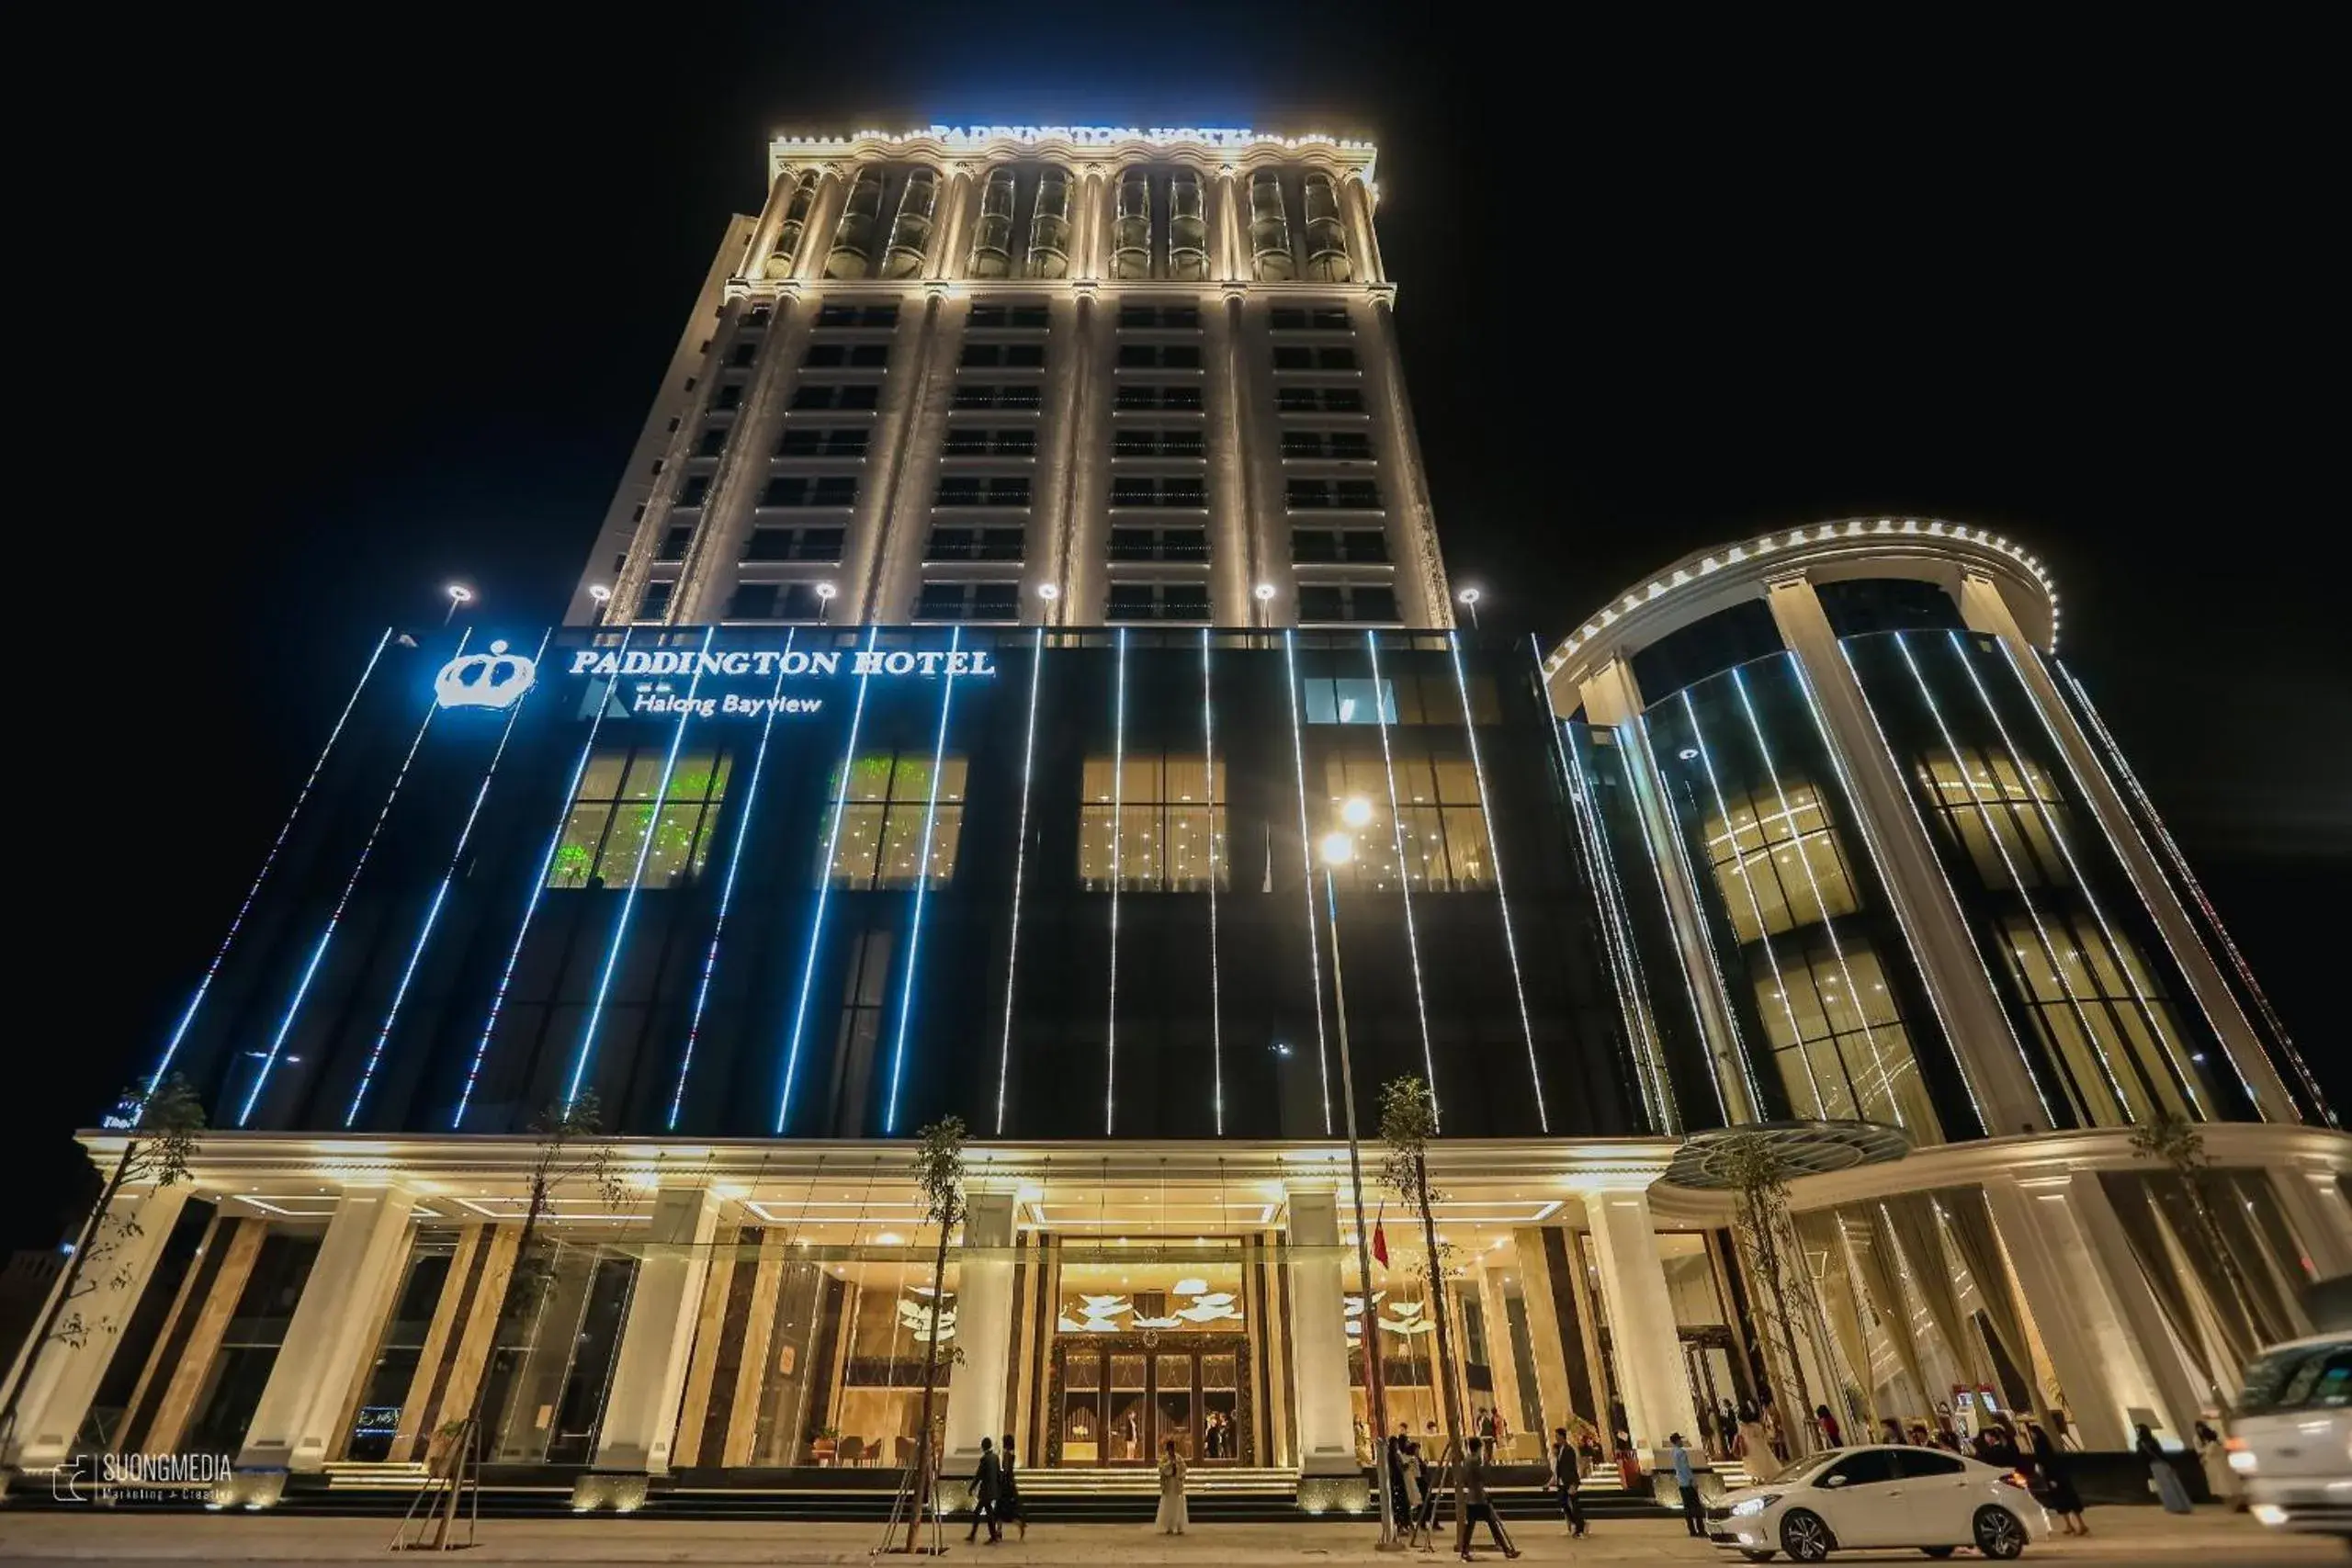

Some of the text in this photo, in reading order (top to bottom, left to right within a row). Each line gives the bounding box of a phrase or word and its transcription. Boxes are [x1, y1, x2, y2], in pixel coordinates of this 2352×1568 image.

[569, 650, 996, 676] PADDINGTON HOTEL
[633, 694, 823, 717] Halong Bayview
